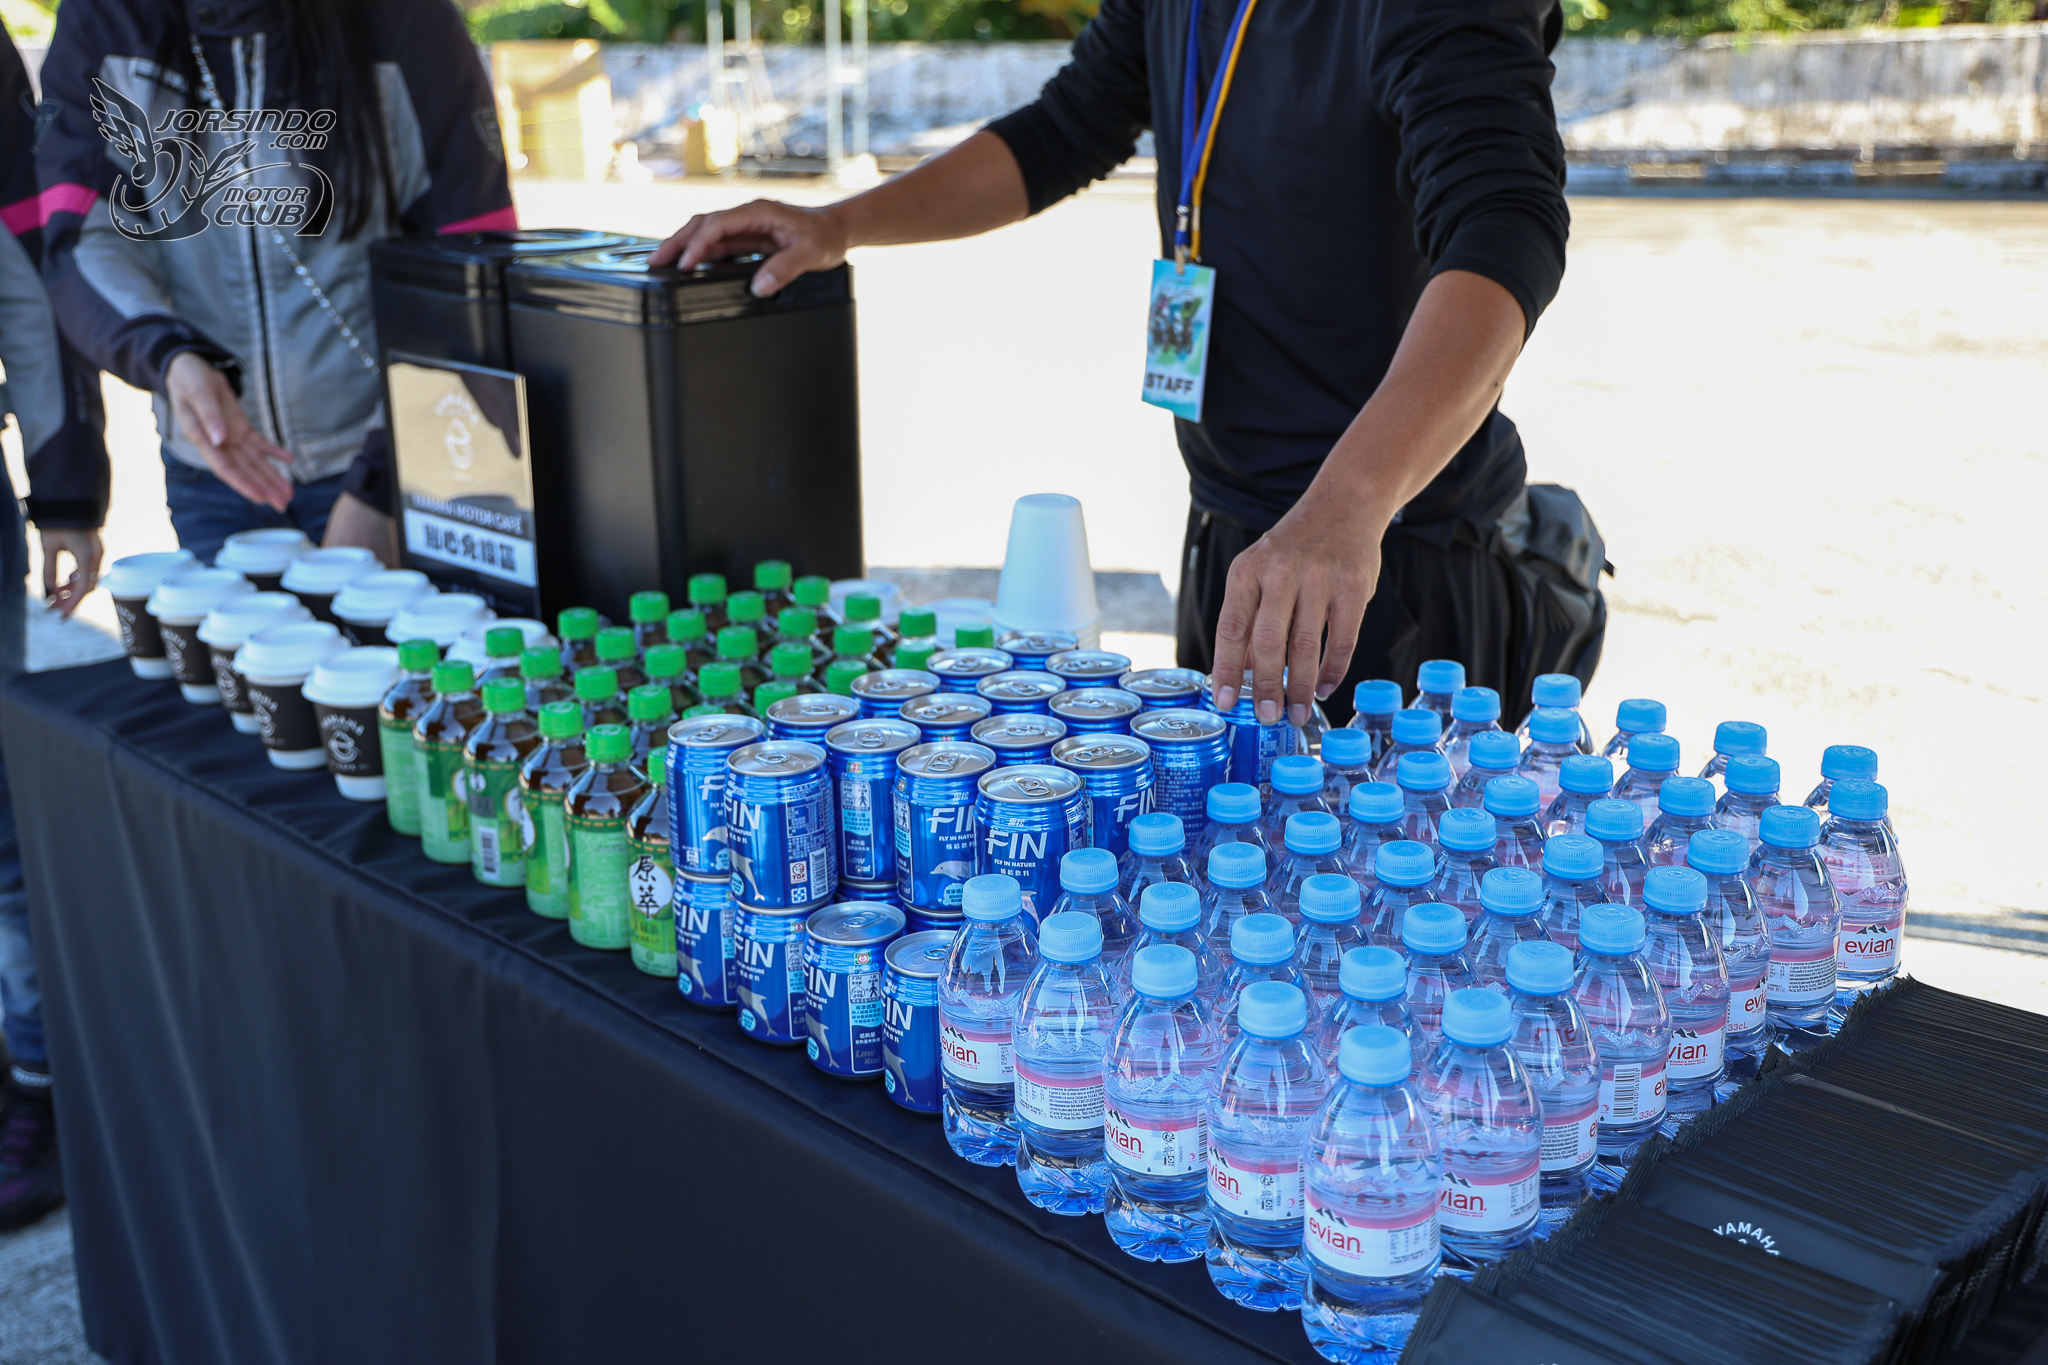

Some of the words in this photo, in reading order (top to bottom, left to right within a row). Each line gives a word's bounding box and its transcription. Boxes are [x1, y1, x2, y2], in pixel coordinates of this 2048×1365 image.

[1145, 373, 1194, 394] STAFF
[958, 833, 974, 841] NATU
[985, 829, 1048, 860] FIN
[855, 1049, 875, 1058] Low
[1639, 1107, 1658, 1120] 33cL
